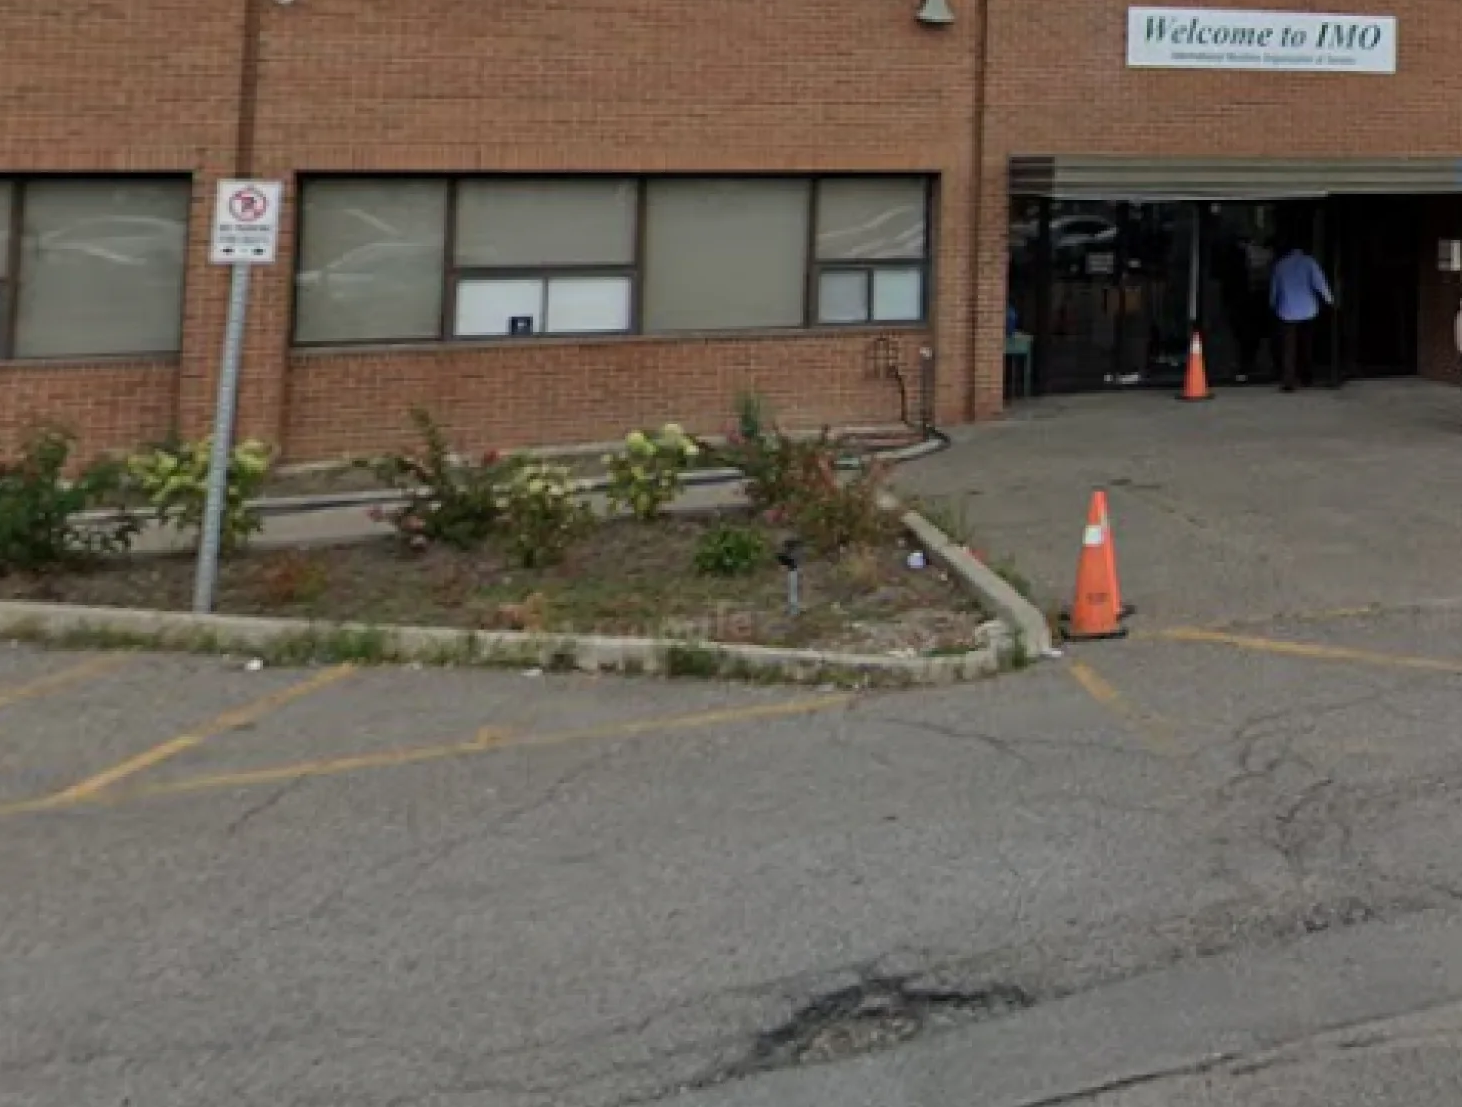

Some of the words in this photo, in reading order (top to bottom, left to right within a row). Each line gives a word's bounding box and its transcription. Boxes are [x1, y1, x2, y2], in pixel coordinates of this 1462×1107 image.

[1144, 15, 1274, 48] Welcome
[1280, 23, 1308, 48] to
[1314, 20, 1382, 51] IMO
